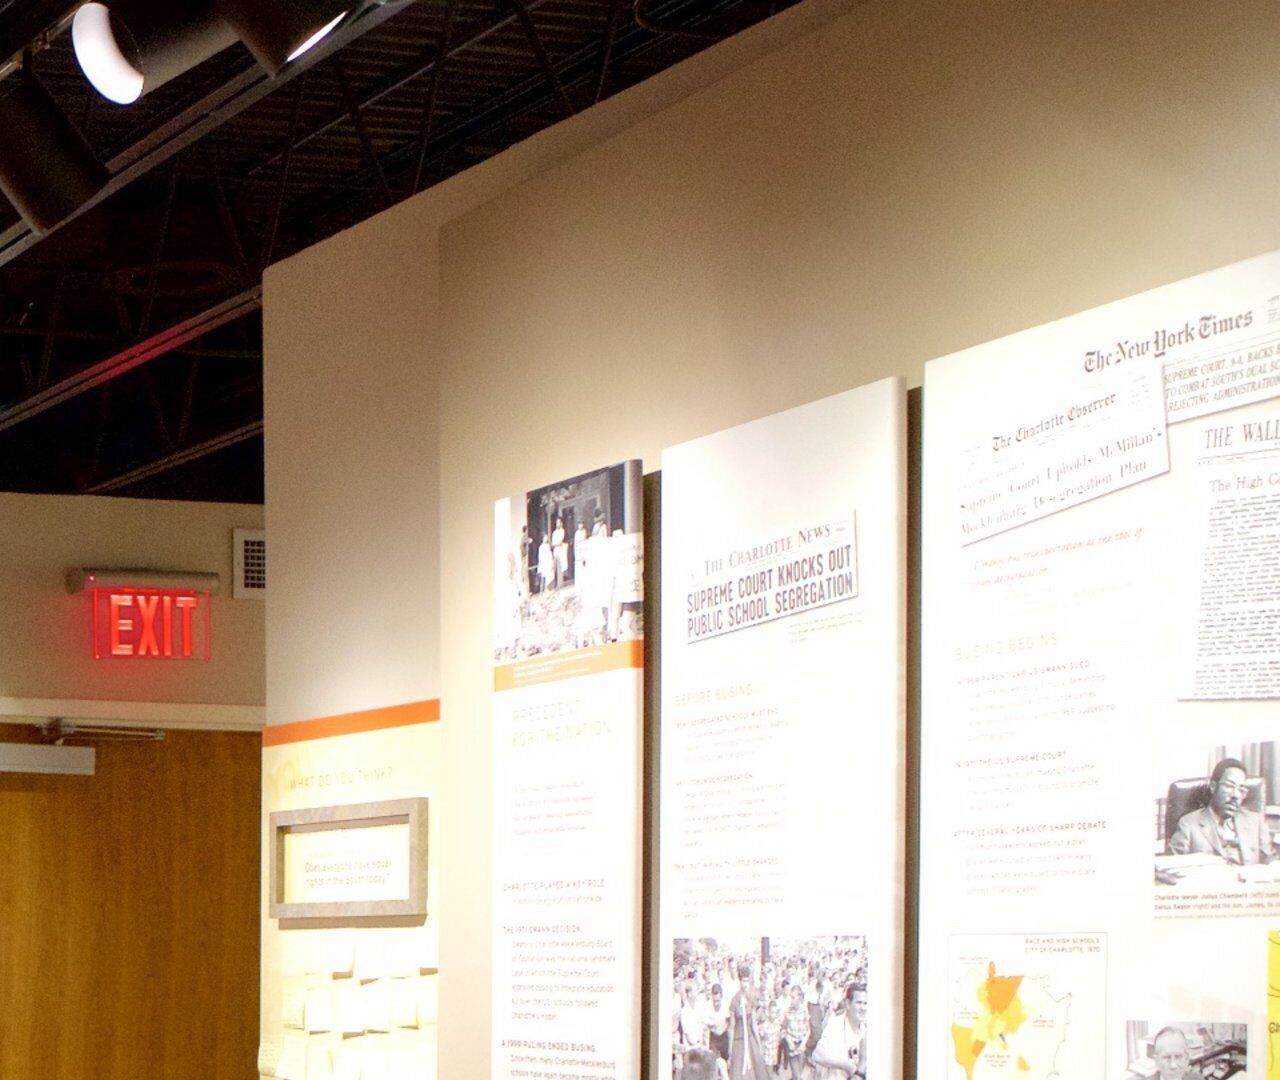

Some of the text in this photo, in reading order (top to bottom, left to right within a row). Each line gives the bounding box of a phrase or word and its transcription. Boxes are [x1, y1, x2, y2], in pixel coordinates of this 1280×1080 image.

[1084, 310, 1253, 373] The New York Times
[1164, 366, 1198, 386] SUPREME
[1178, 378, 1209, 396] COMBAT
[1246, 364, 1267, 383] DUAL
[992, 393, 1116, 452] The Charlotte Observer
[1168, 392, 1209, 413] REJECTING
[1205, 426, 1234, 449] THE
[1209, 479, 1231, 493] The
[1237, 474, 1263, 490] High
[705, 523, 831, 576] THE CHARLOTTE NEWS
[687, 544, 852, 614] SUPREME COURT KNOCKS OUT
[110, 594, 198, 657] EXIT
[688, 609, 723, 638] PUBLIC
[729, 596, 769, 627] SCHOOL
[775, 572, 853, 614] SEGREGATION
[290, 775, 314, 790] WHAT
